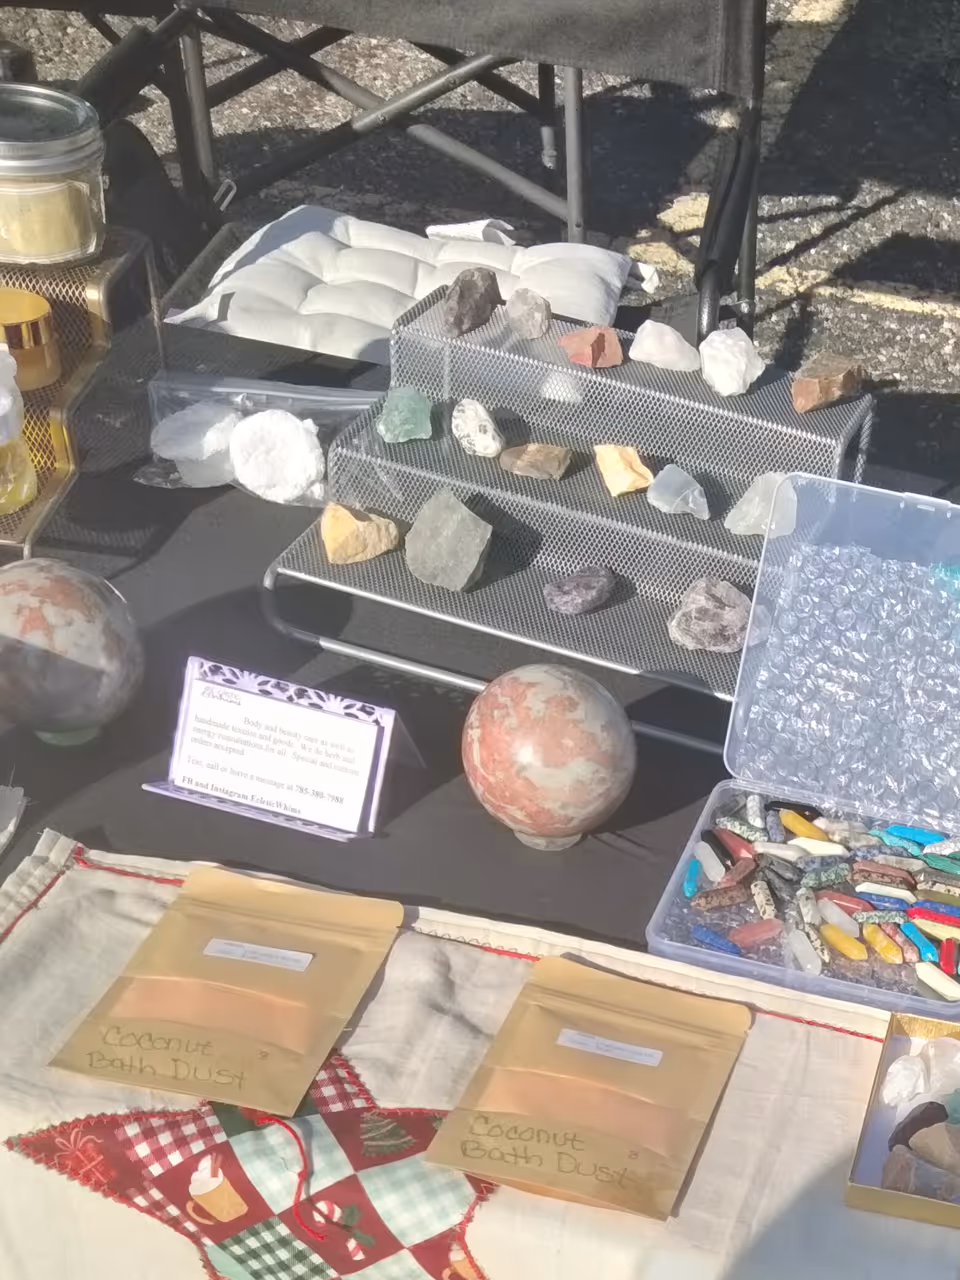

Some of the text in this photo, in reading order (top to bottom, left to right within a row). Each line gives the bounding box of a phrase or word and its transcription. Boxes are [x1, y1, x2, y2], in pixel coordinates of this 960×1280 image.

[194, 781, 209, 790] and
[102, 1026, 215, 1057] Coconut
[86, 1051, 156, 1075] Bath
[471, 1115, 585, 1151] Coconut
[460, 1140, 543, 1167] Bath
